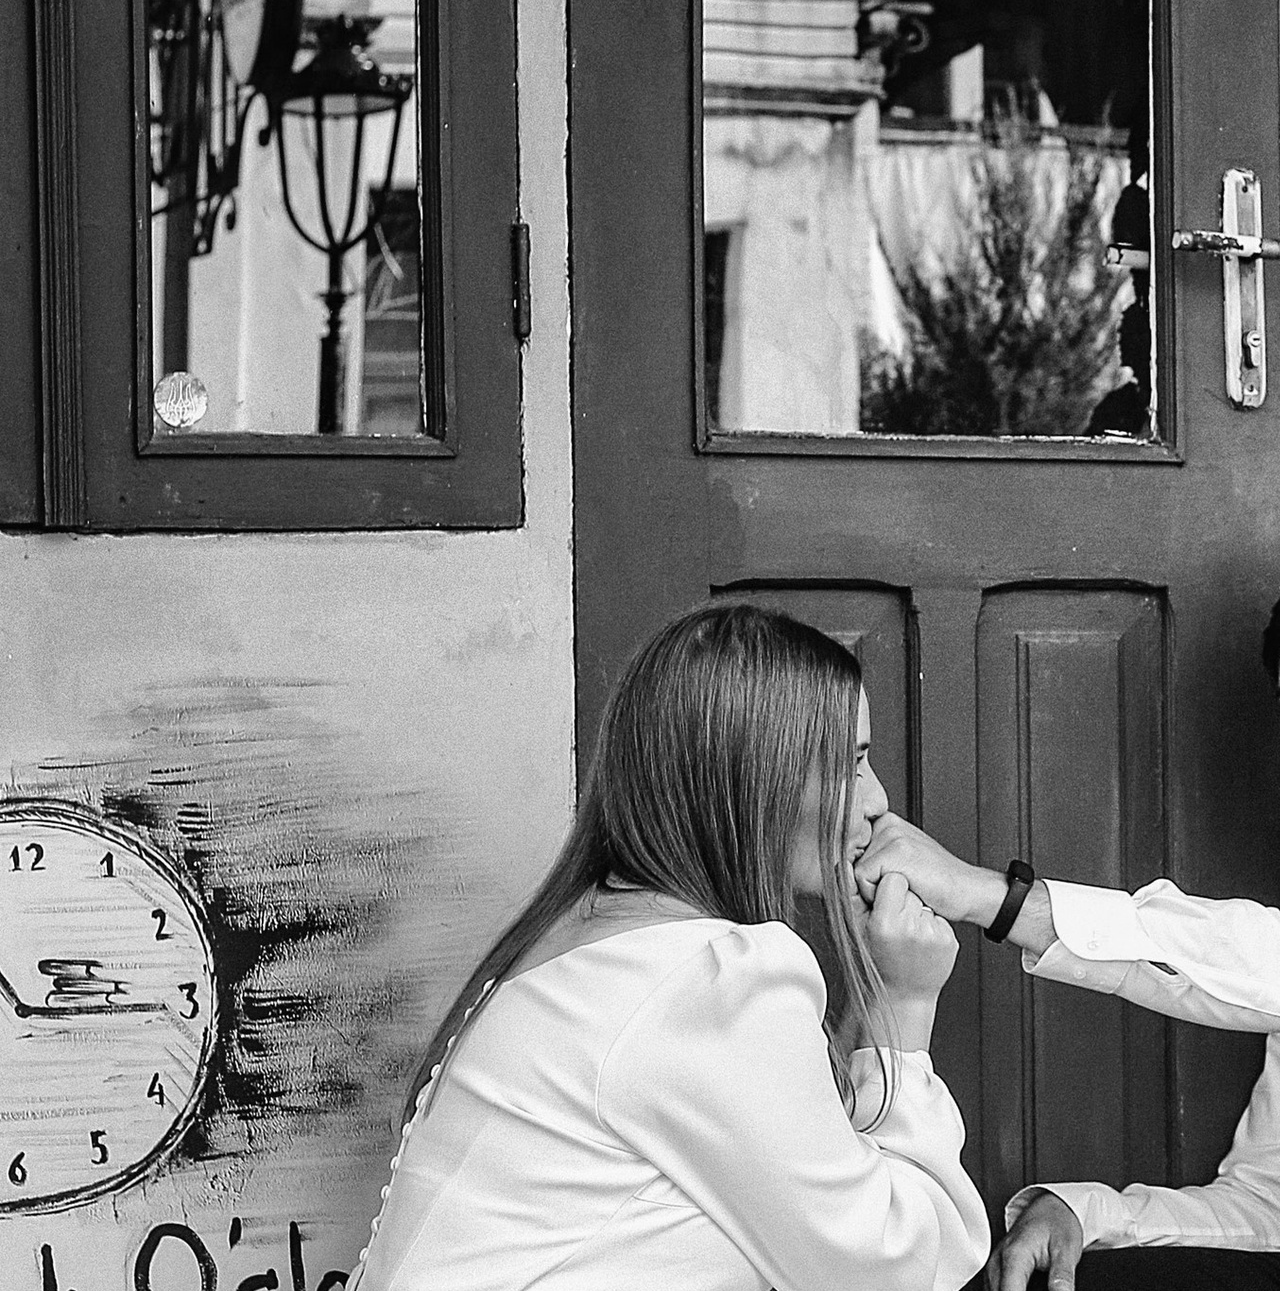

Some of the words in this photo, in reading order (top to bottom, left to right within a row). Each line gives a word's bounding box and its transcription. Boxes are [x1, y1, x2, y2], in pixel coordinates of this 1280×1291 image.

[9, 843, 46, 871] 12
[99, 851, 117, 878] 1
[151, 908, 174, 941] 2
[177, 982, 199, 1020] 3
[147, 1072, 166, 1108] 4
[90, 1130, 109, 1164] 5
[8, 1151, 27, 1186] 6
